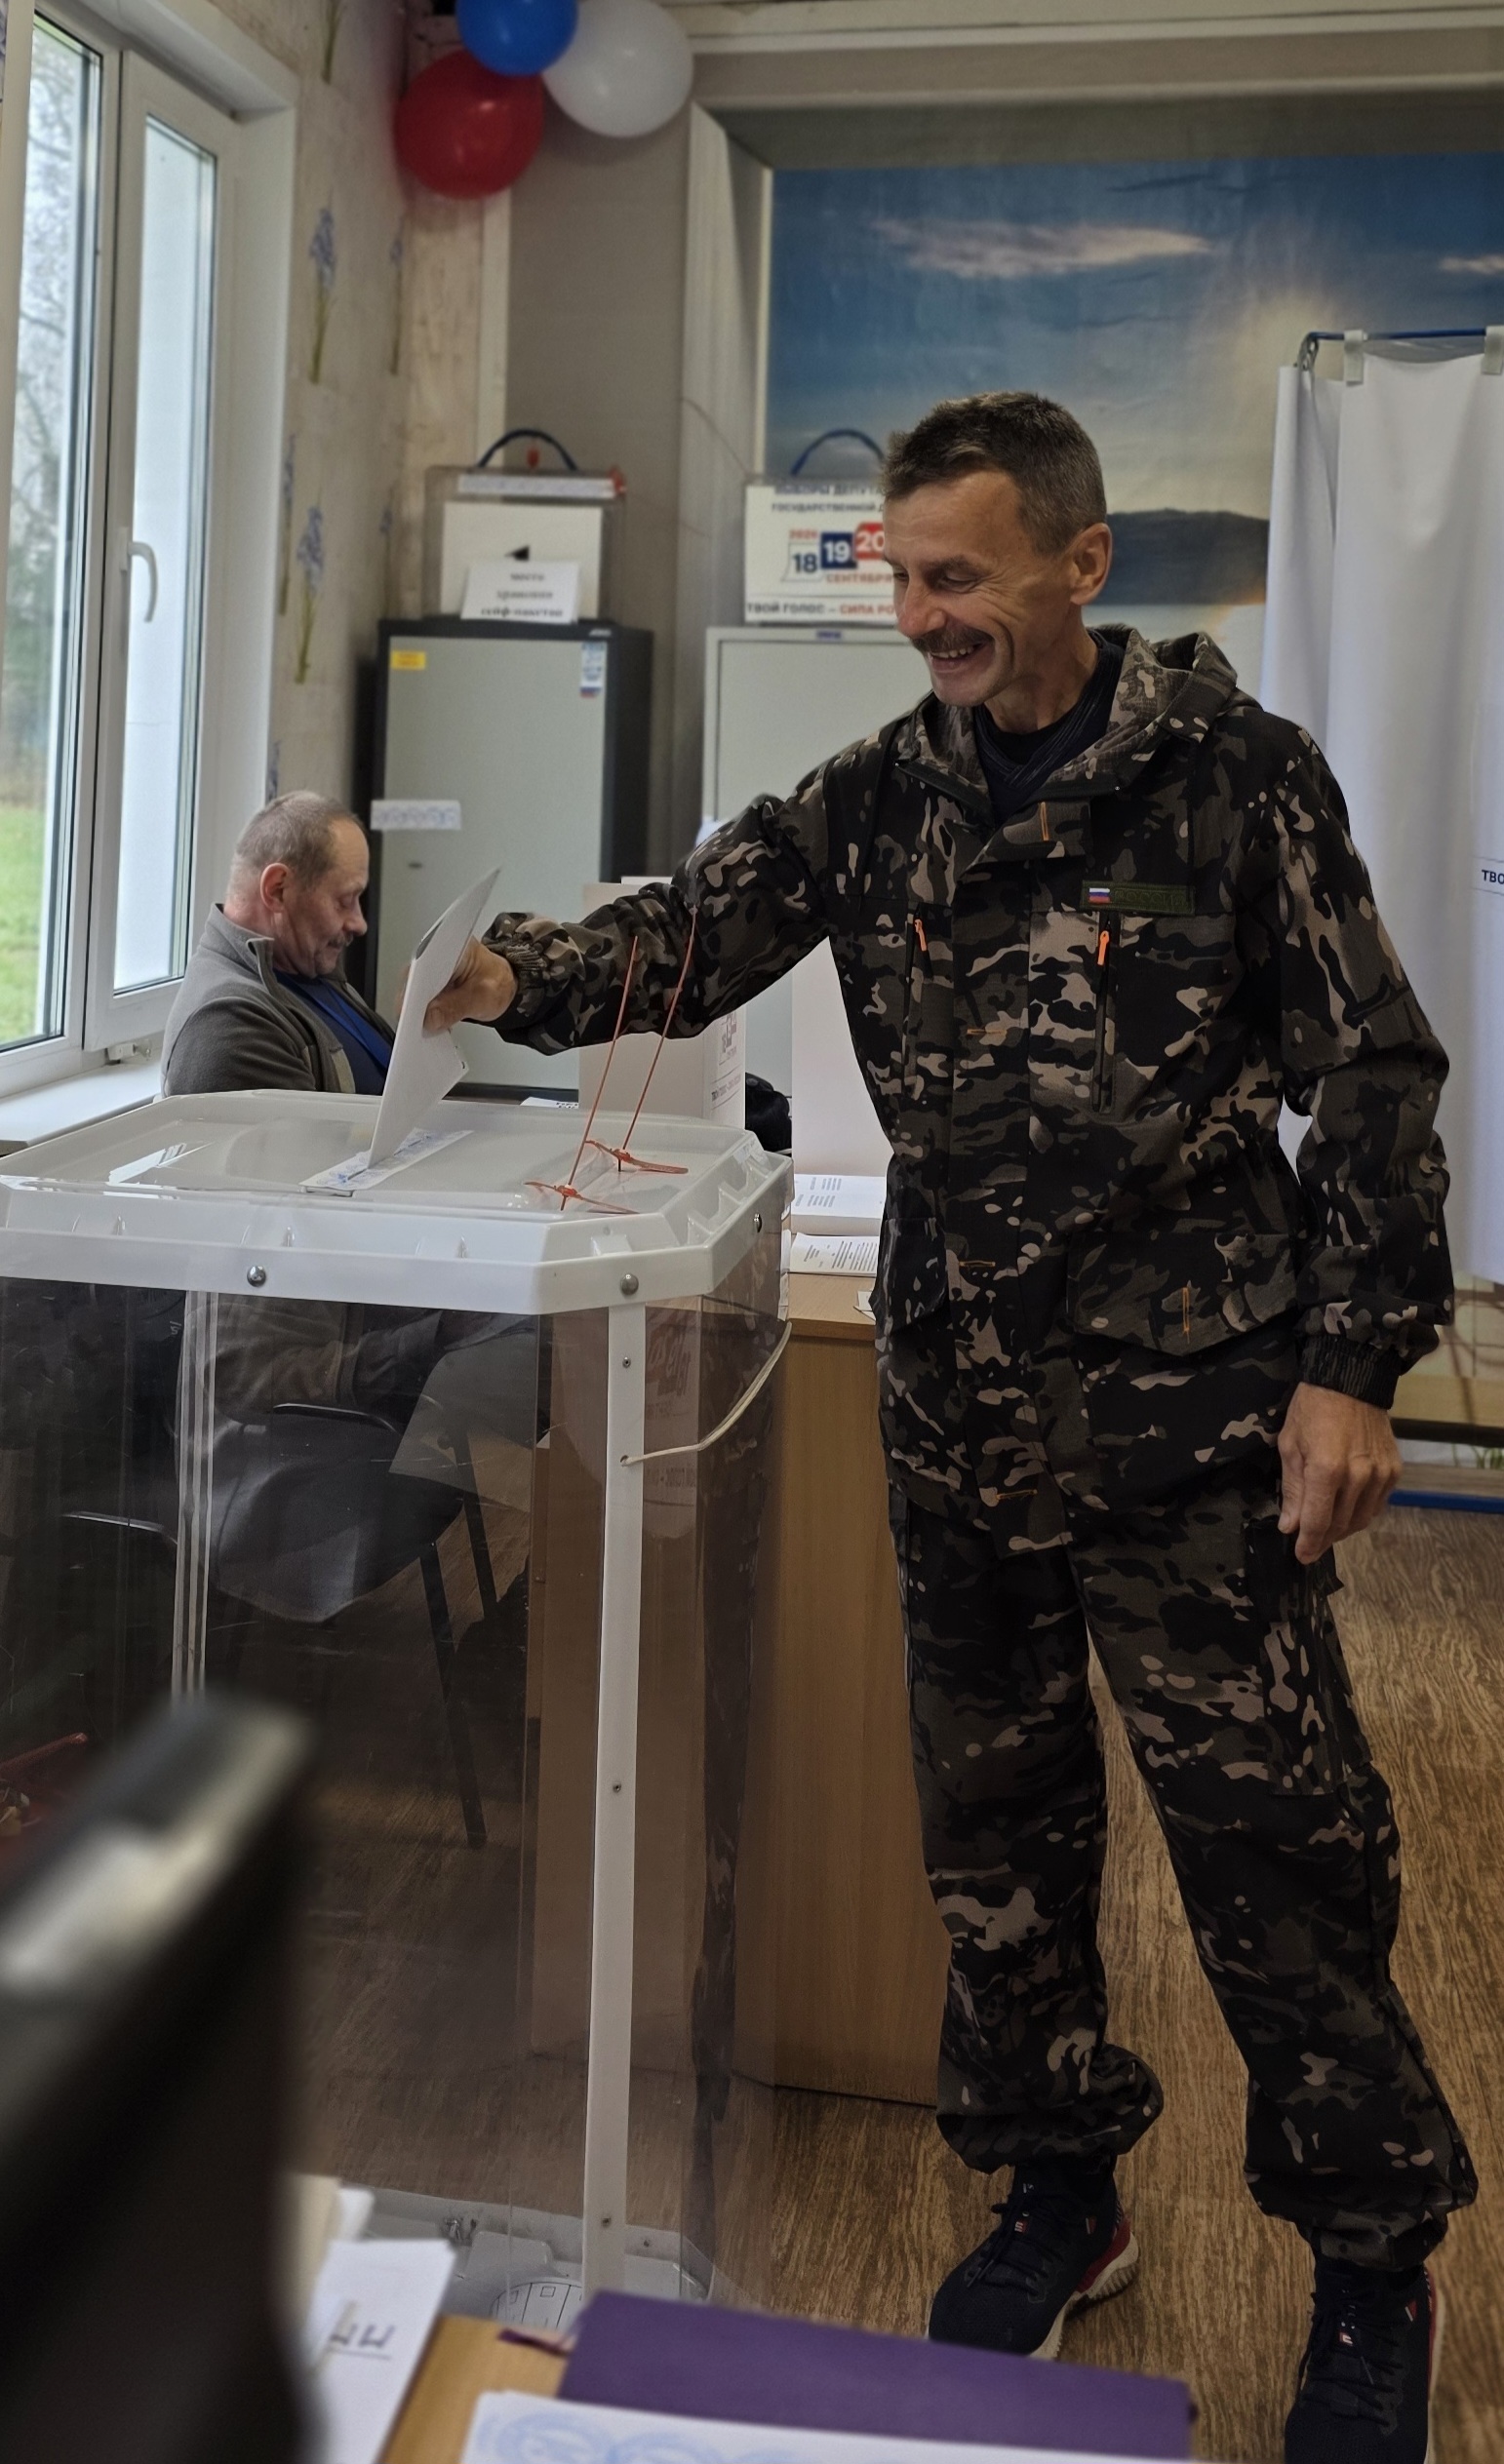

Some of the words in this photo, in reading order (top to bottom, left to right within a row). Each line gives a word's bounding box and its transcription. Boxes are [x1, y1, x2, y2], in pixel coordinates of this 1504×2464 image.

[793, 553, 817, 573] 18
[824, 540, 851, 563] 19
[856, 531, 885, 552] 20
[747, 601, 779, 613] ТВОЙ
[783, 603, 825, 614] ГОЛОС
